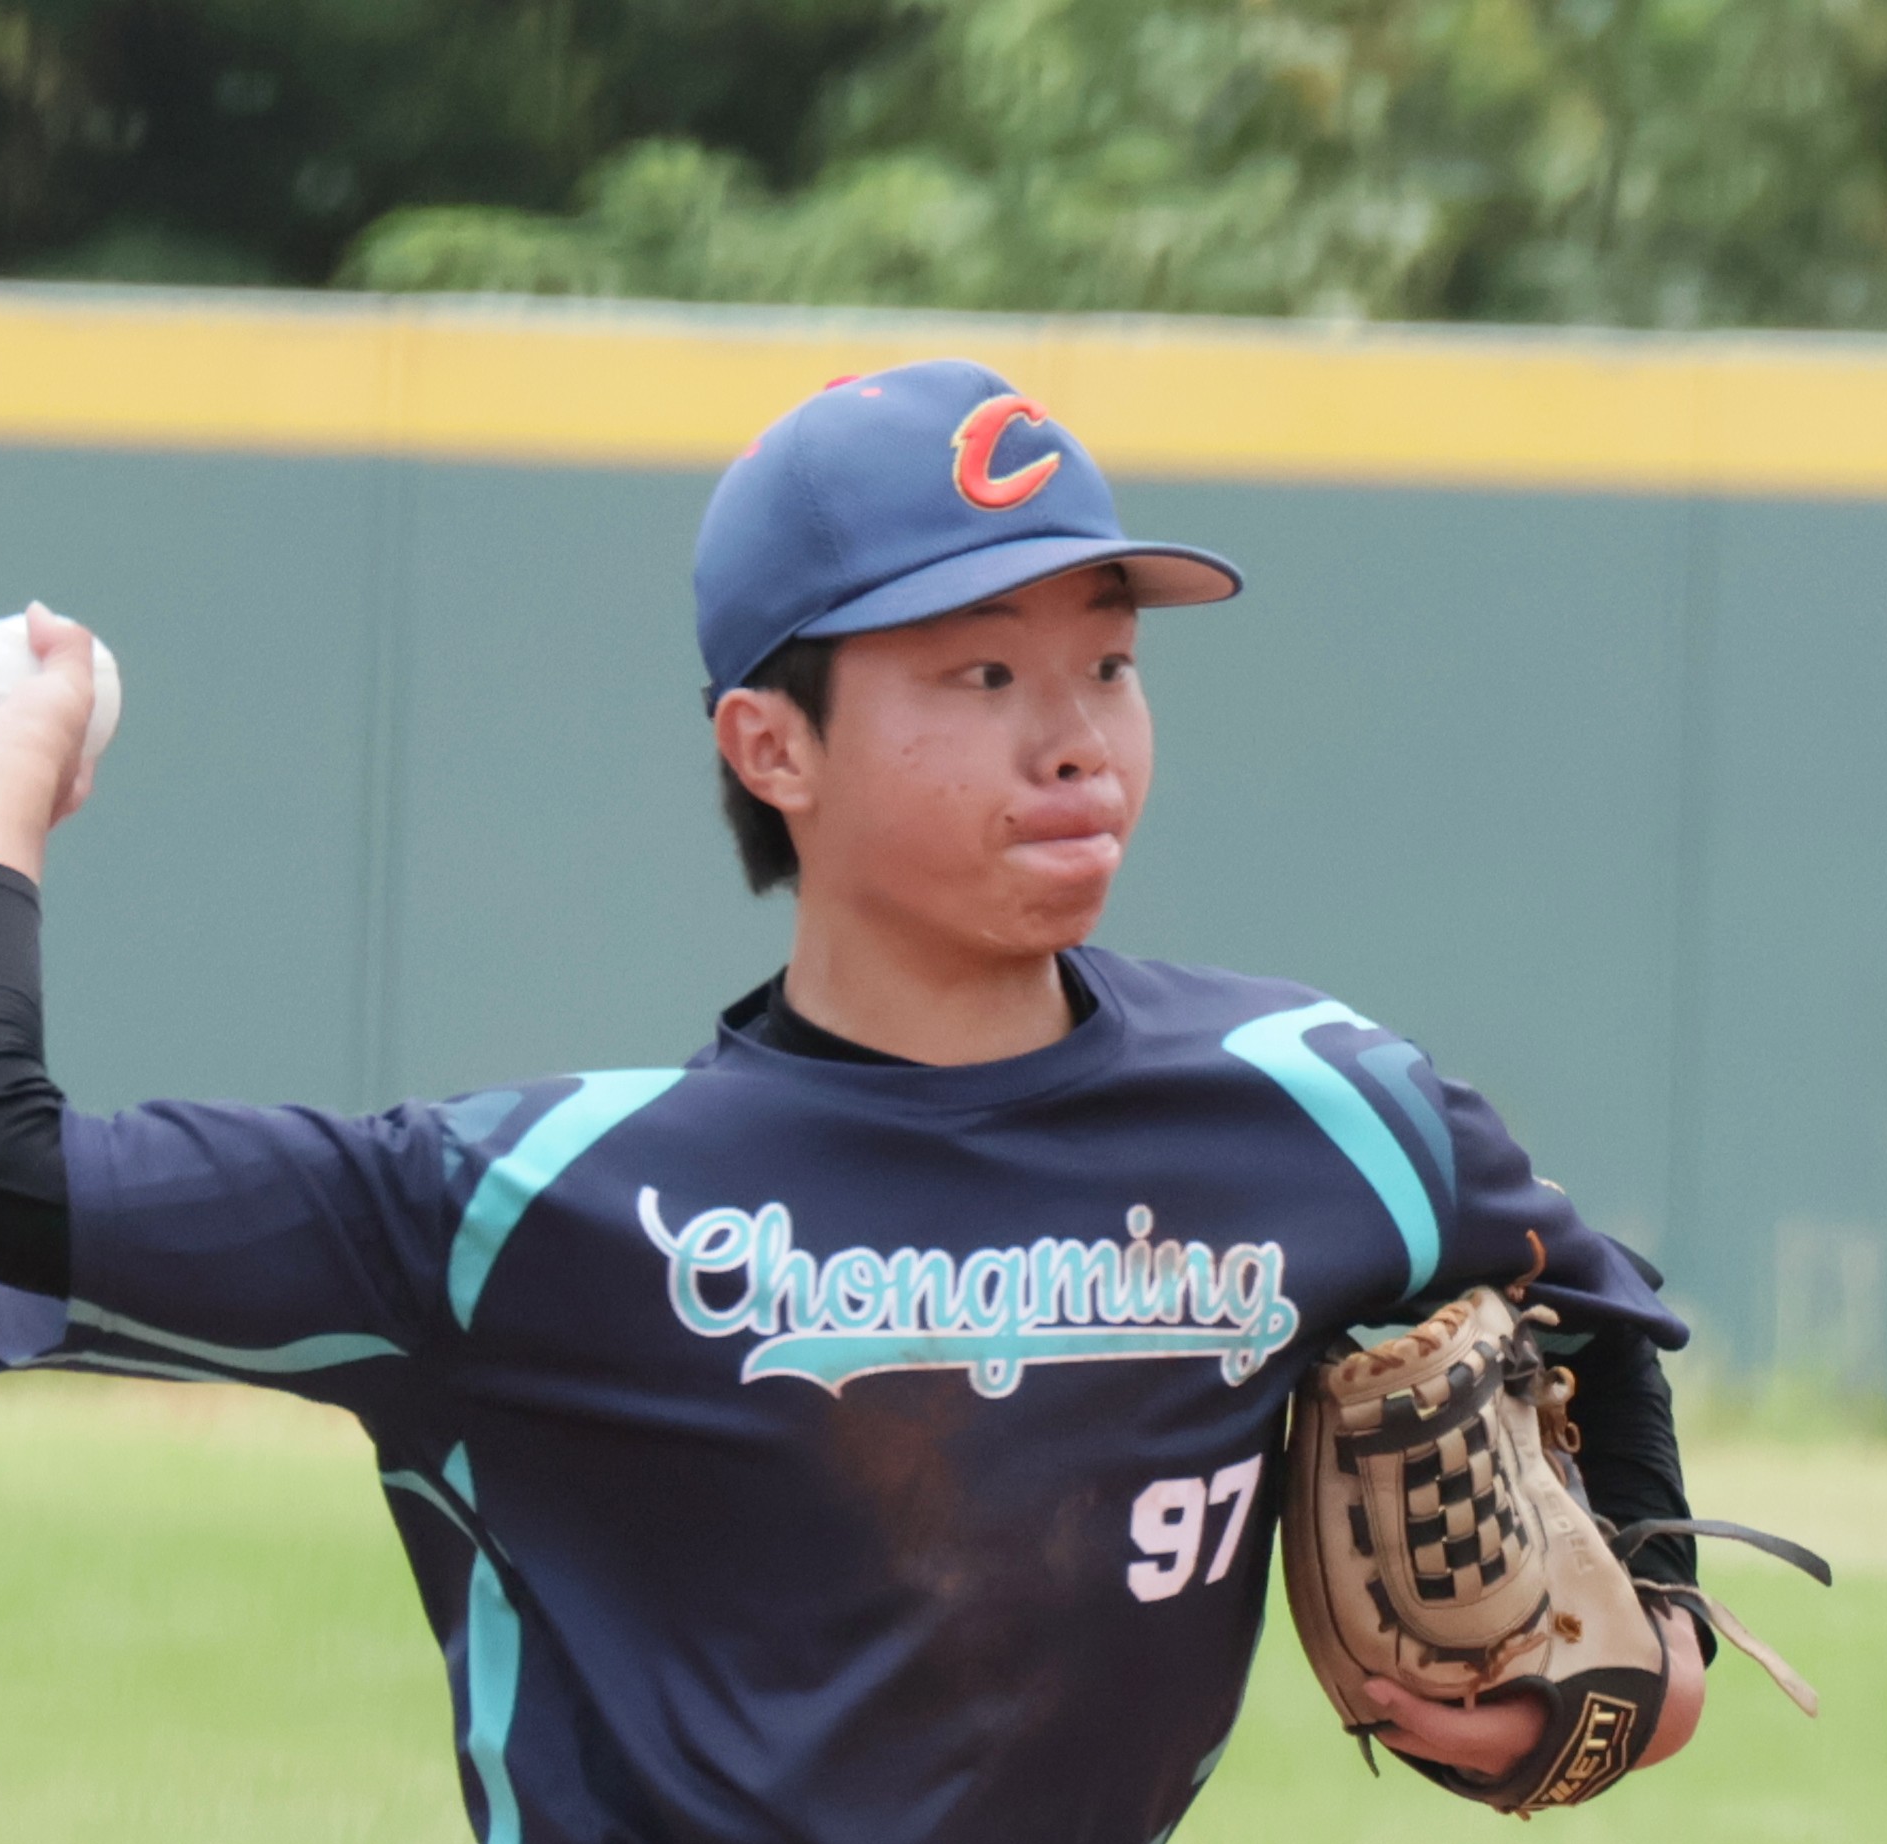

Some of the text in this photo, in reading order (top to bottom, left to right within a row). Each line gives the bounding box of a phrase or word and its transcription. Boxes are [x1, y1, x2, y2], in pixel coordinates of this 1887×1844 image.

[950, 394, 1061, 511] C
[637, 1186, 1299, 1399] Chongming
[1126, 1454, 1262, 1602] 97
